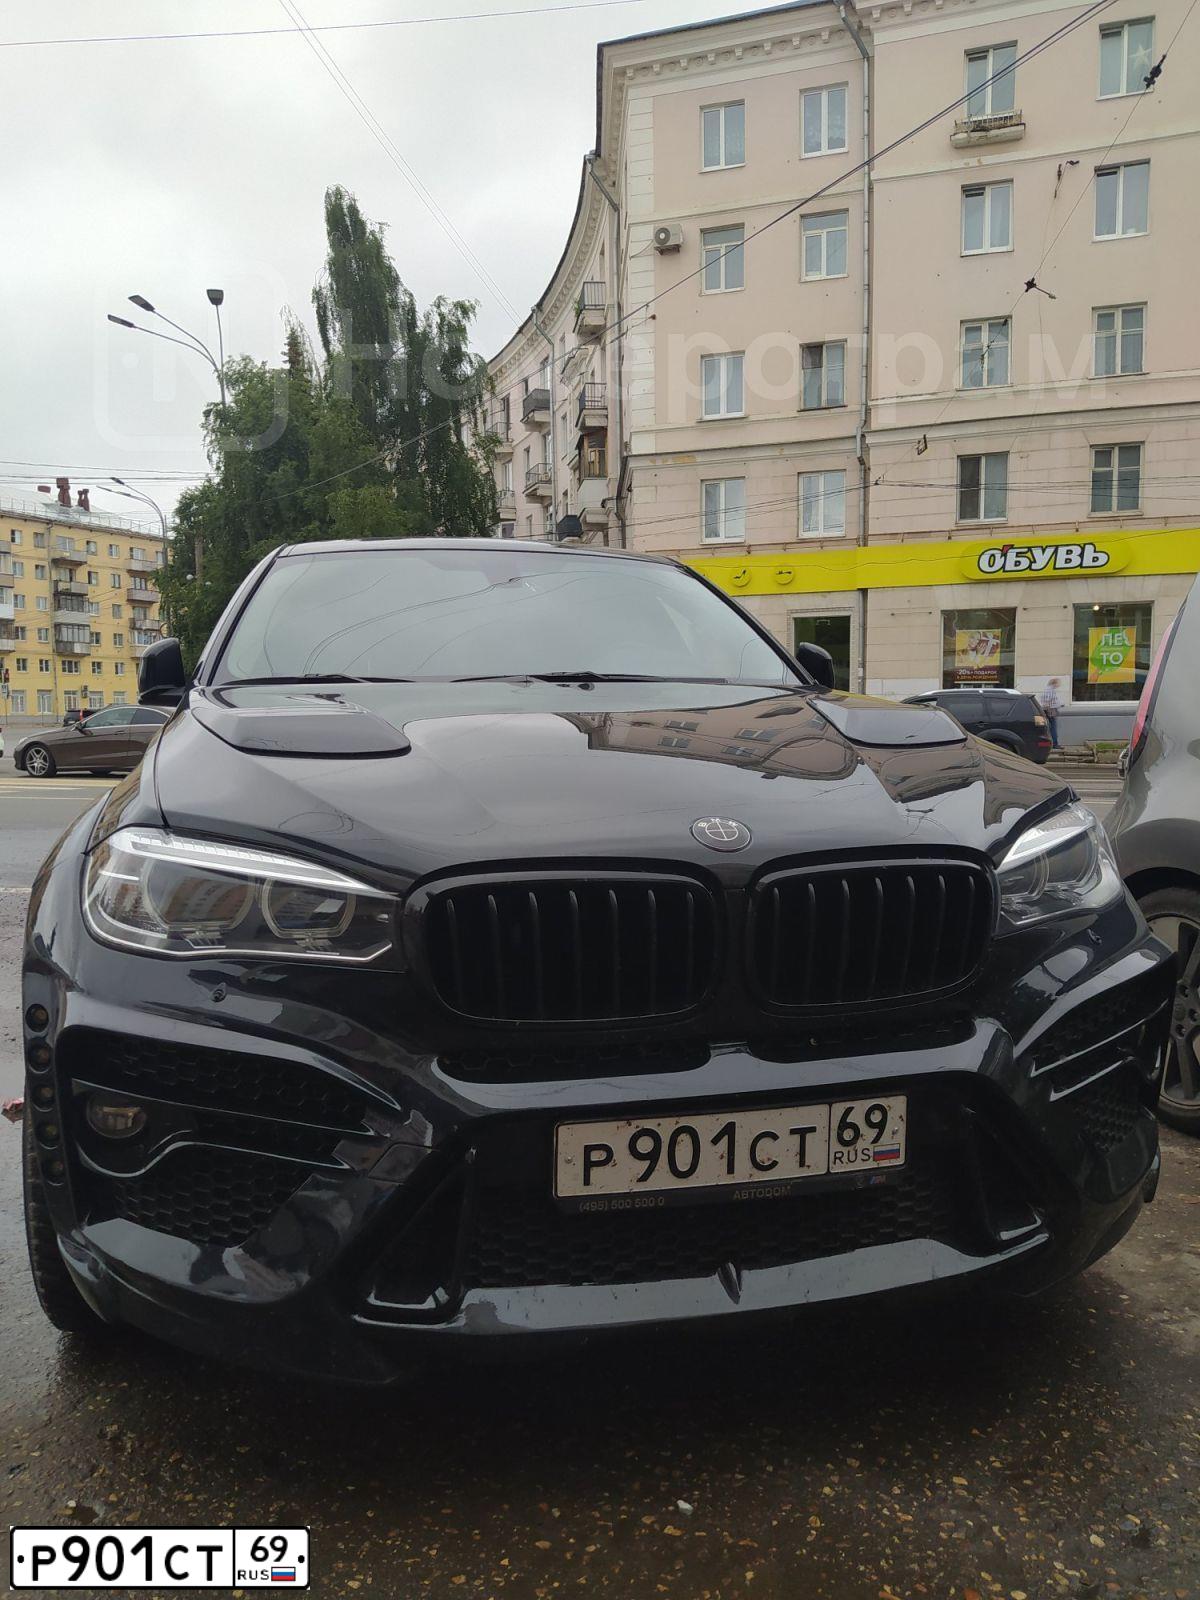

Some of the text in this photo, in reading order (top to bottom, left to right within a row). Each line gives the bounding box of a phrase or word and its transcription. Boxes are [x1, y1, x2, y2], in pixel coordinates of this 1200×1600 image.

[1100, 652, 1123, 665] ТО
[836, 1103, 888, 1148] 69
[833, 1148, 871, 1166] RUS
